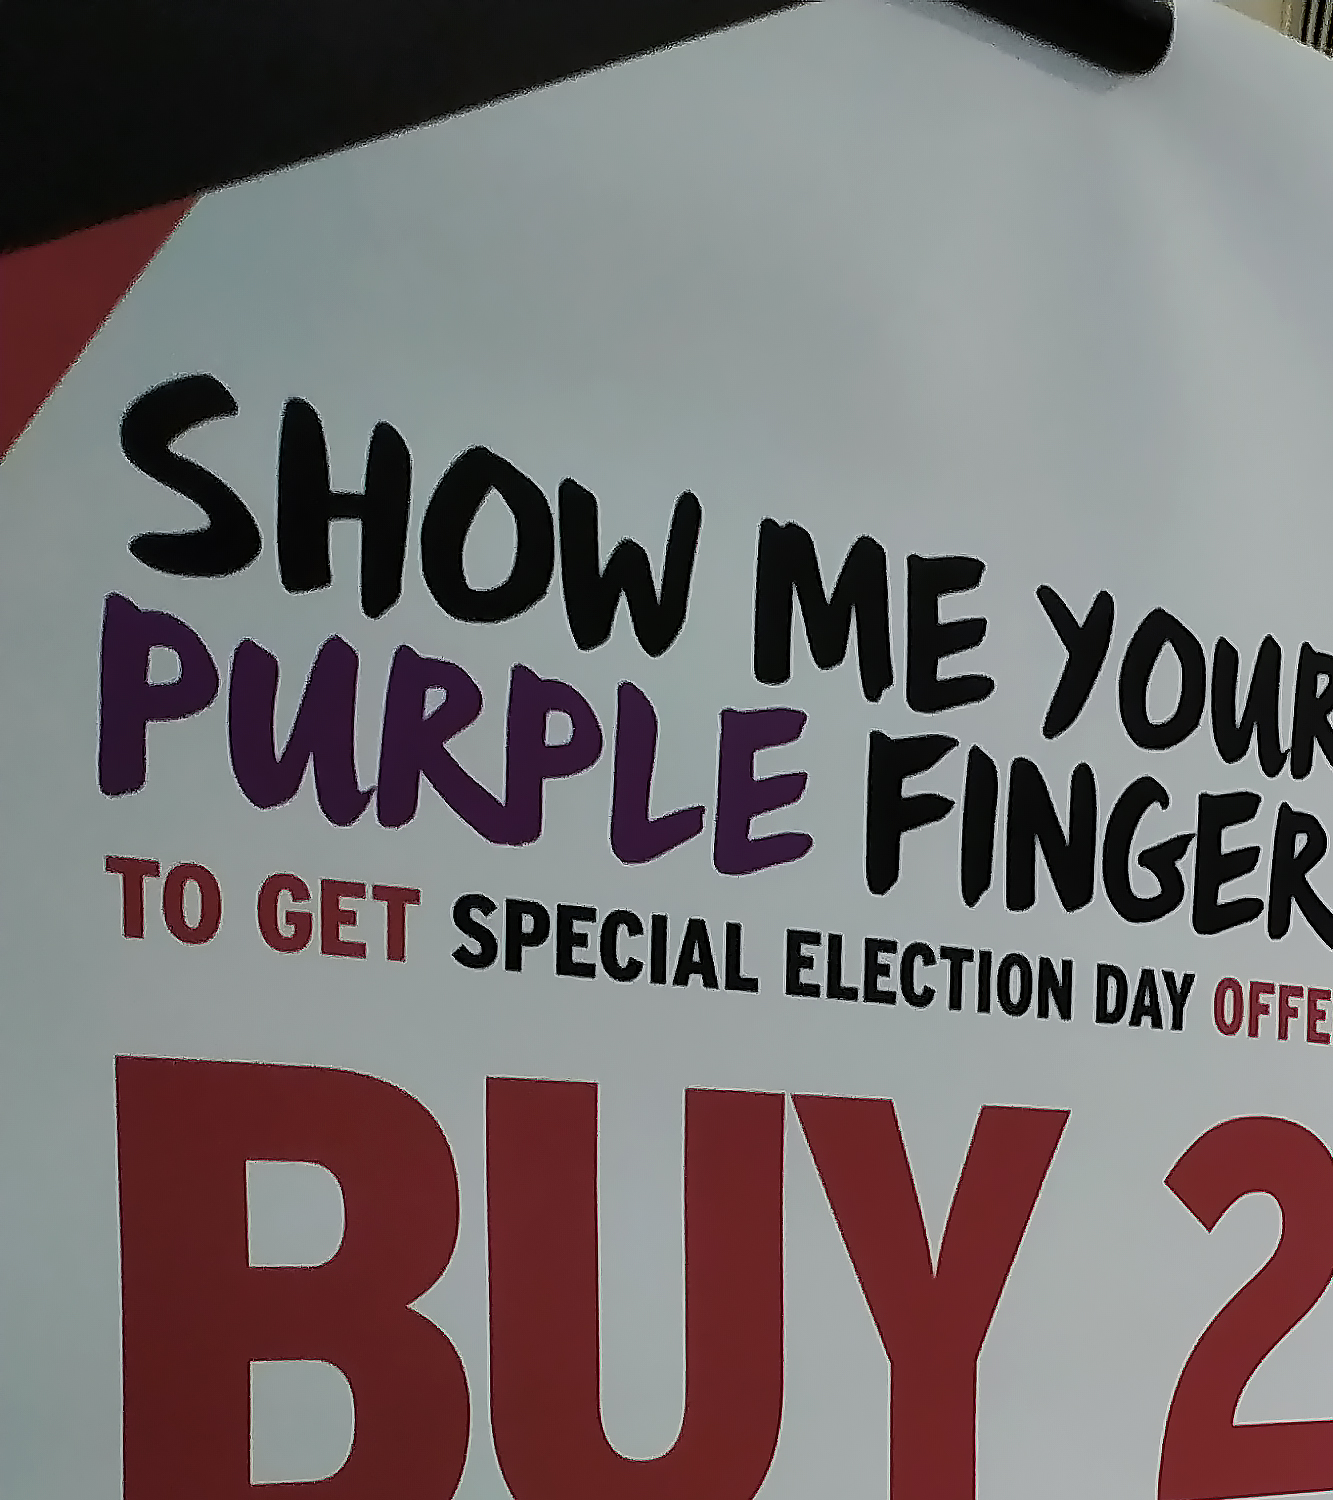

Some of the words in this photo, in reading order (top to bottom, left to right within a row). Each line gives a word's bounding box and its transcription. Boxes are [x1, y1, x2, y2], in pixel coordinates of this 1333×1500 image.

[120, 374, 704, 658] SHOW
[753, 517, 997, 714] ME
[97, 593, 814, 876] PURPLE
[104, 853, 222, 945] TO
[256, 872, 421, 965] GET
[451, 892, 761, 998] SPECIAL
[785, 929, 1075, 1024] ELECTION
[1092, 958, 1198, 1037] DAY
